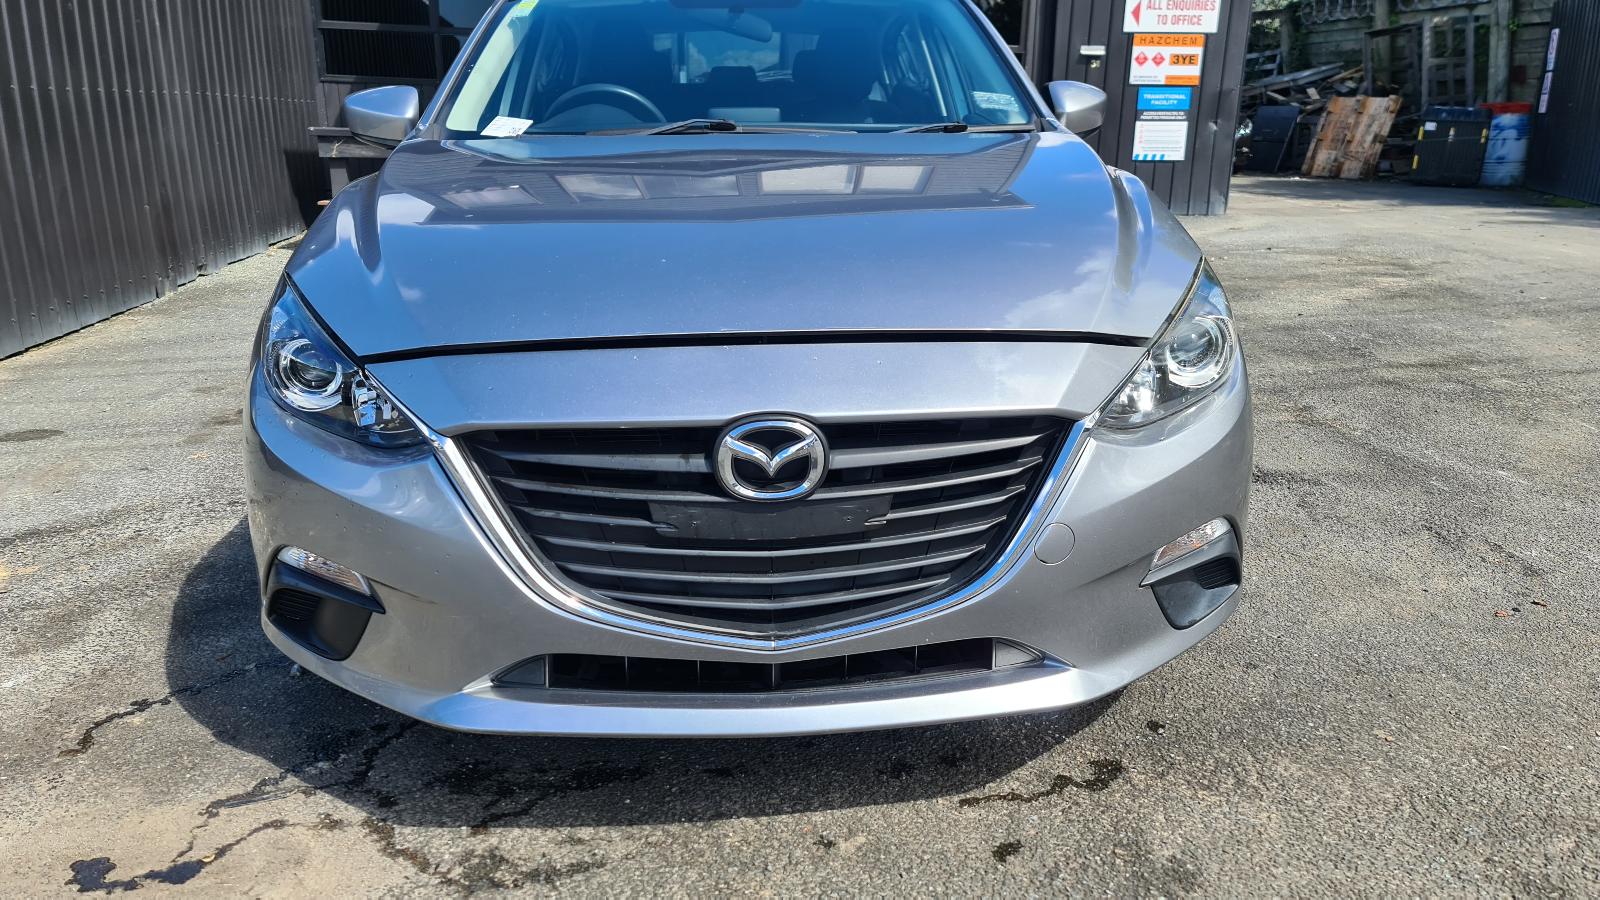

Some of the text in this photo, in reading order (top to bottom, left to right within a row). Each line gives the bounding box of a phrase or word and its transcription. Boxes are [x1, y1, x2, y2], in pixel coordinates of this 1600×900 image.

[1146, 0, 1216, 11] ALL ENQUIRIES
[1157, 14, 1203, 25] TO OFFICE
[1139, 36, 1198, 45] HAZCHEM
[1173, 55, 1195, 64] 3YE
